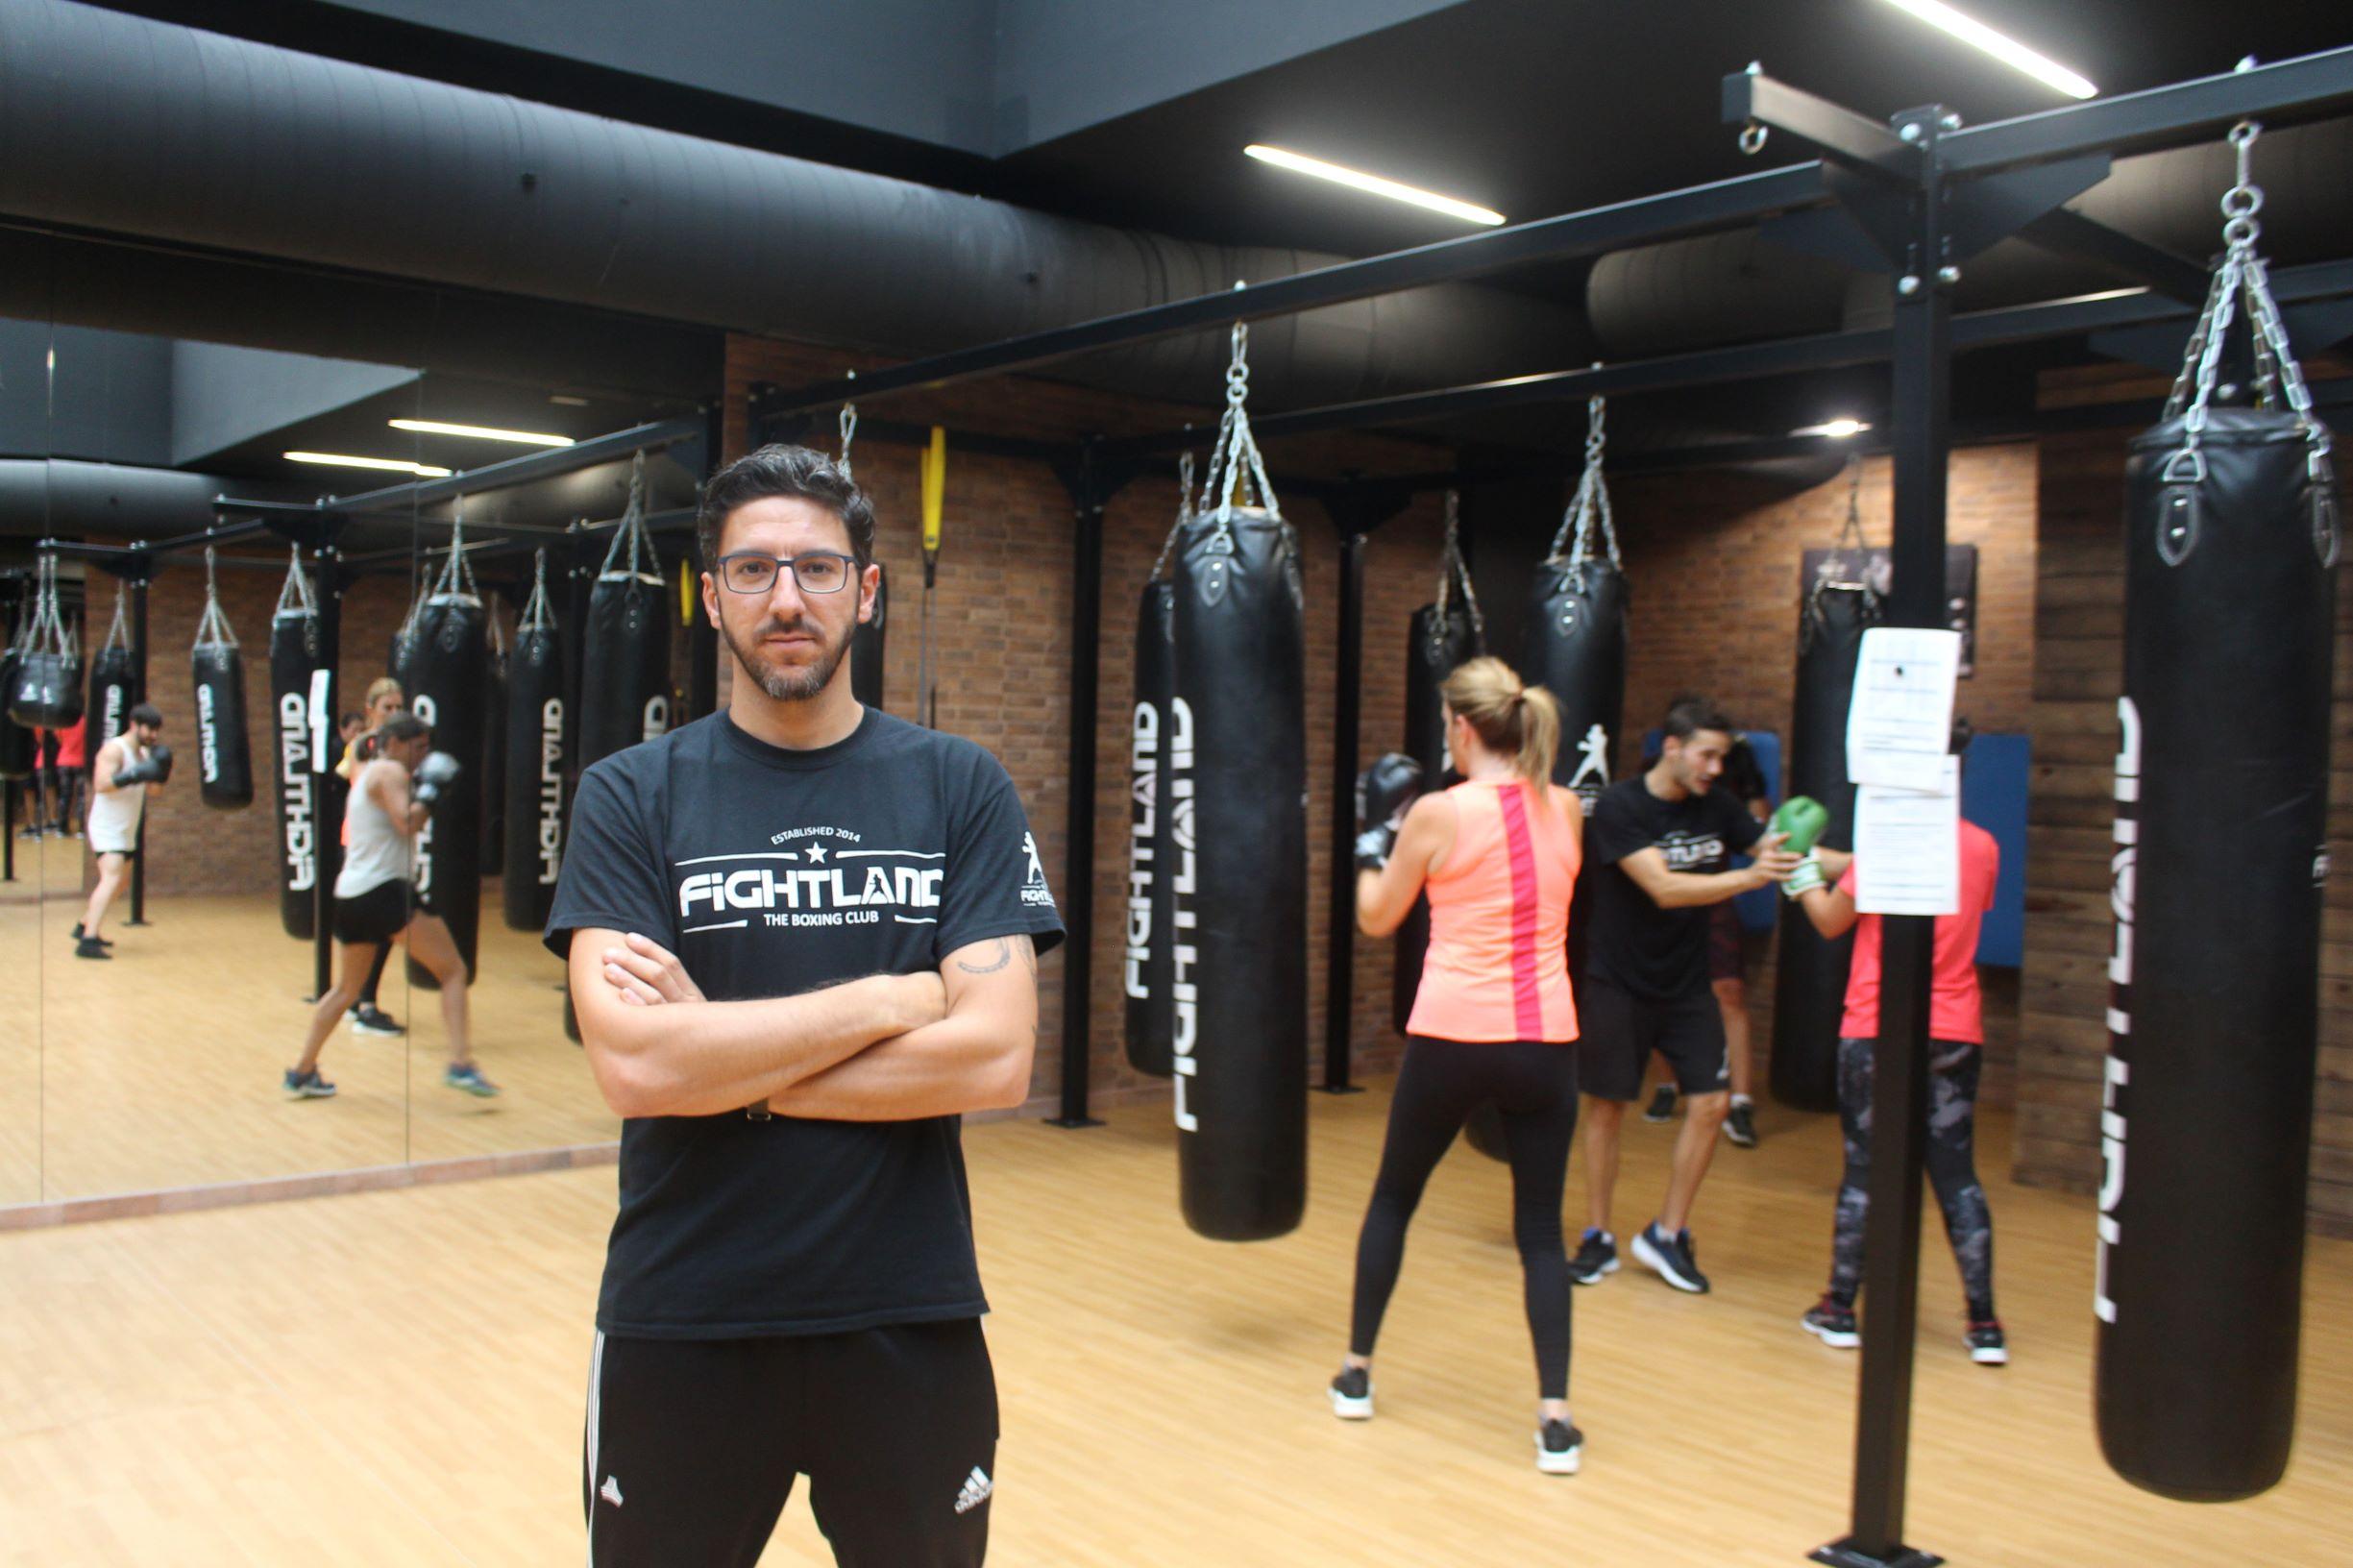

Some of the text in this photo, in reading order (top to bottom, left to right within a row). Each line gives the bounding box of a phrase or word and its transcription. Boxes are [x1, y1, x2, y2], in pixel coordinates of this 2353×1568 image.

[771, 826, 861, 845] ESTABLISHED 2014
[764, 910, 879, 926] THE BOXING CLUB
